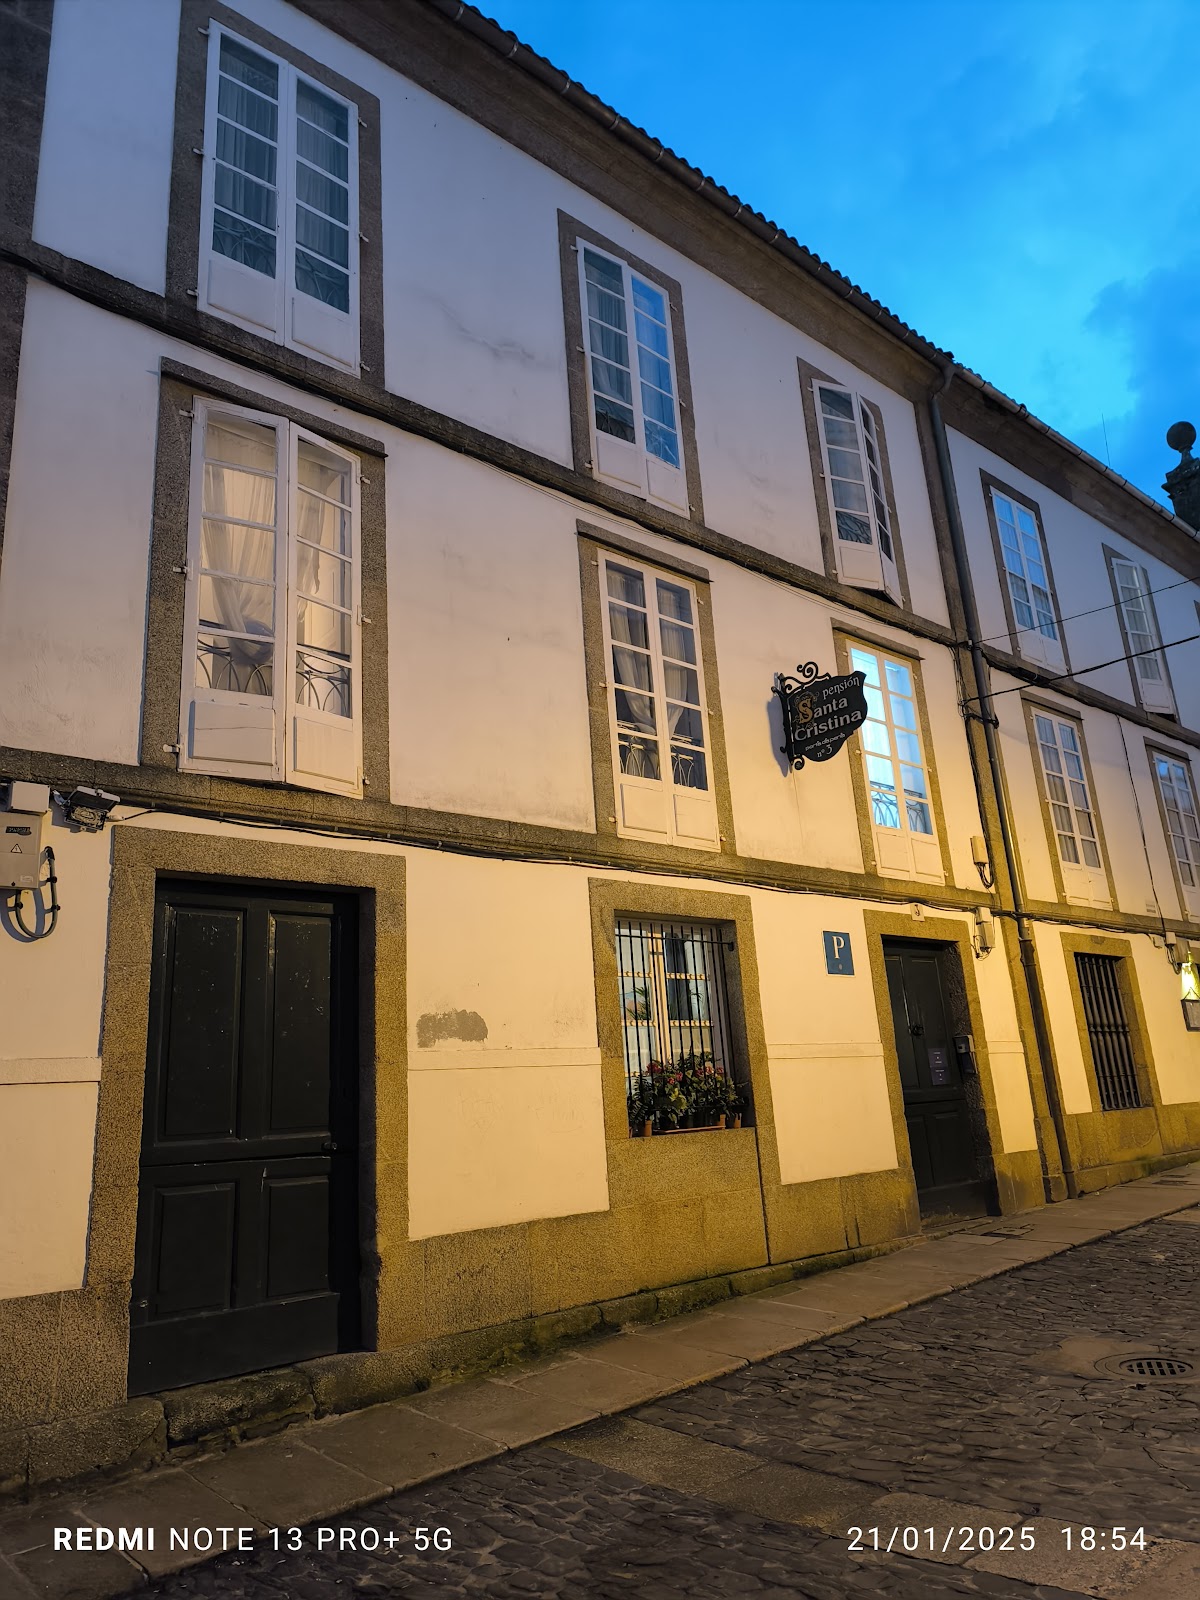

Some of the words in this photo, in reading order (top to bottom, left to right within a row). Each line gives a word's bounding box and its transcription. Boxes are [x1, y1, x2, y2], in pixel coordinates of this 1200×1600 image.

[822, 676, 861, 700] pensión
[797, 697, 849, 724] Santa
[794, 710, 863, 741] Cristina
[825, 744, 833, 755] 3
[832, 935, 845, 959] P
